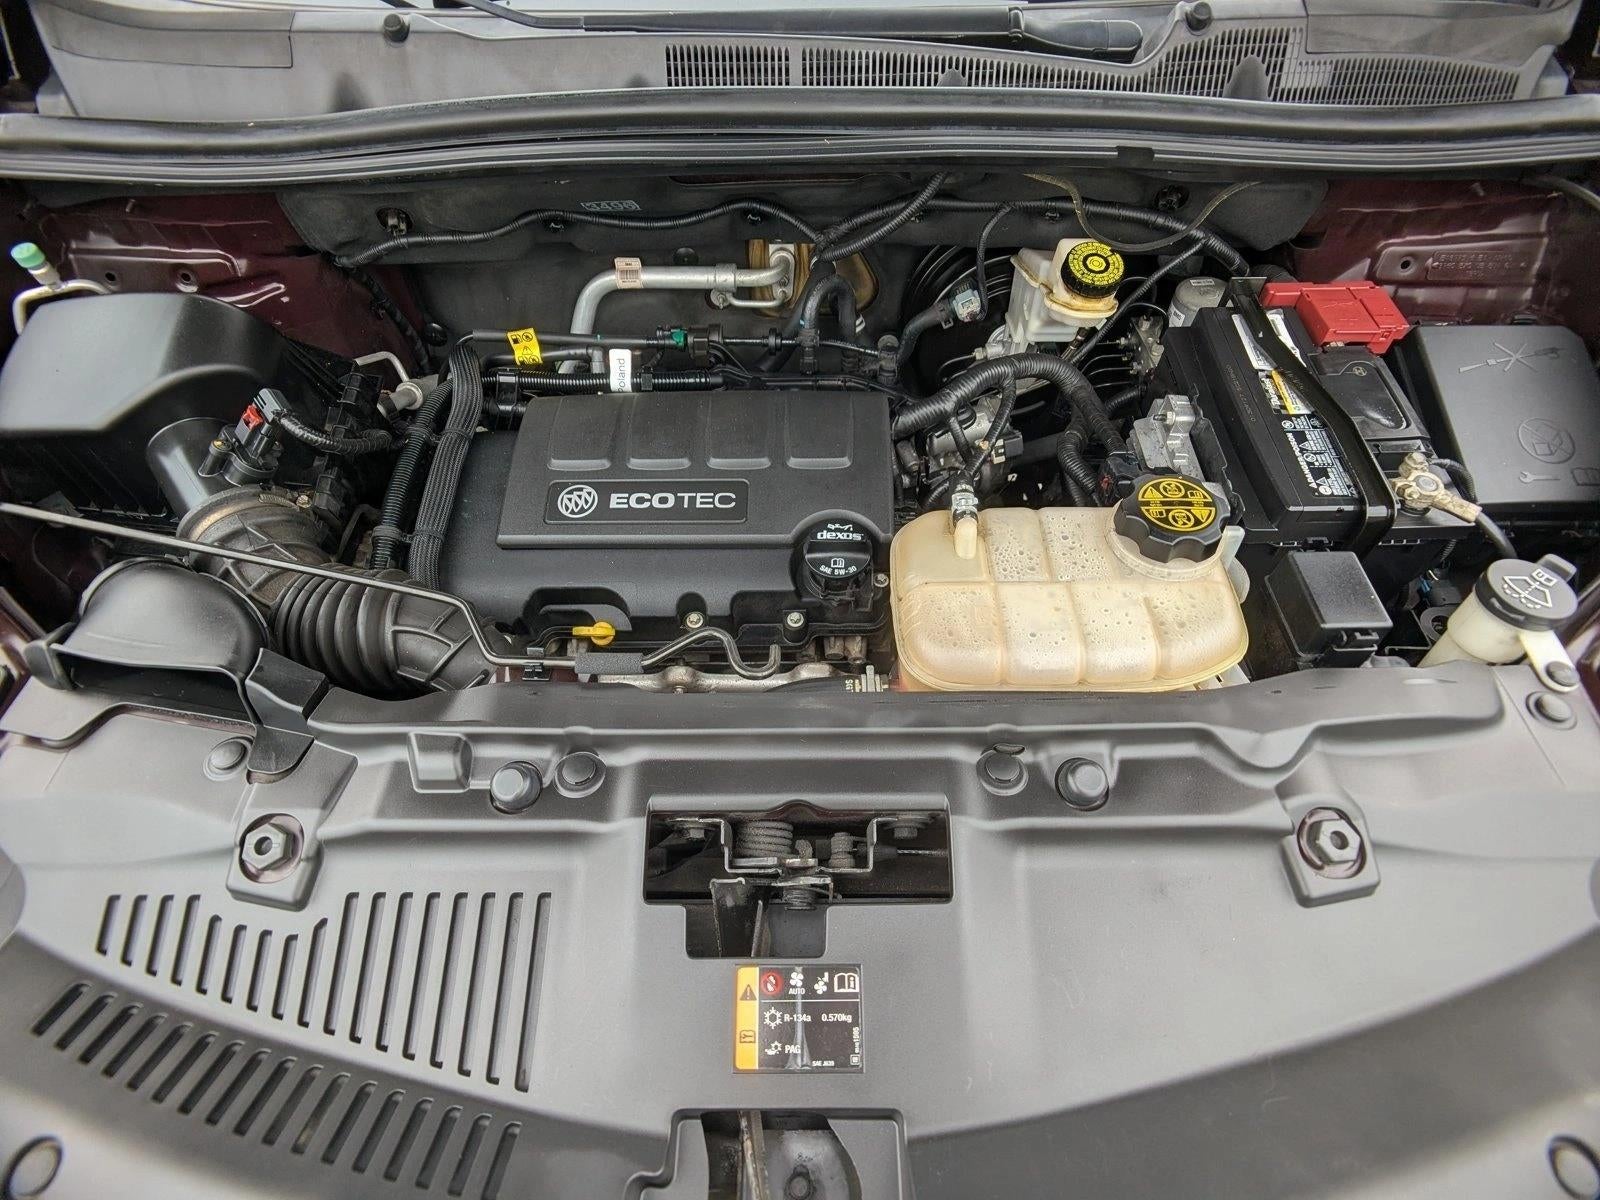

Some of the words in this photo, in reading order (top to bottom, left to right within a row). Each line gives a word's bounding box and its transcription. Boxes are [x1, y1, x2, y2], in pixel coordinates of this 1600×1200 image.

[609, 492, 736, 509] ECOTEC
[816, 529, 862, 541] dexos
[819, 564, 833, 575] SAE
[834, 565, 858, 576] 5W-30
[788, 987, 806, 996] AUTO
[783, 1013, 812, 1022] R-134a
[821, 1013, 853, 1024] 0.570kg
[784, 1044, 801, 1054] PAG
